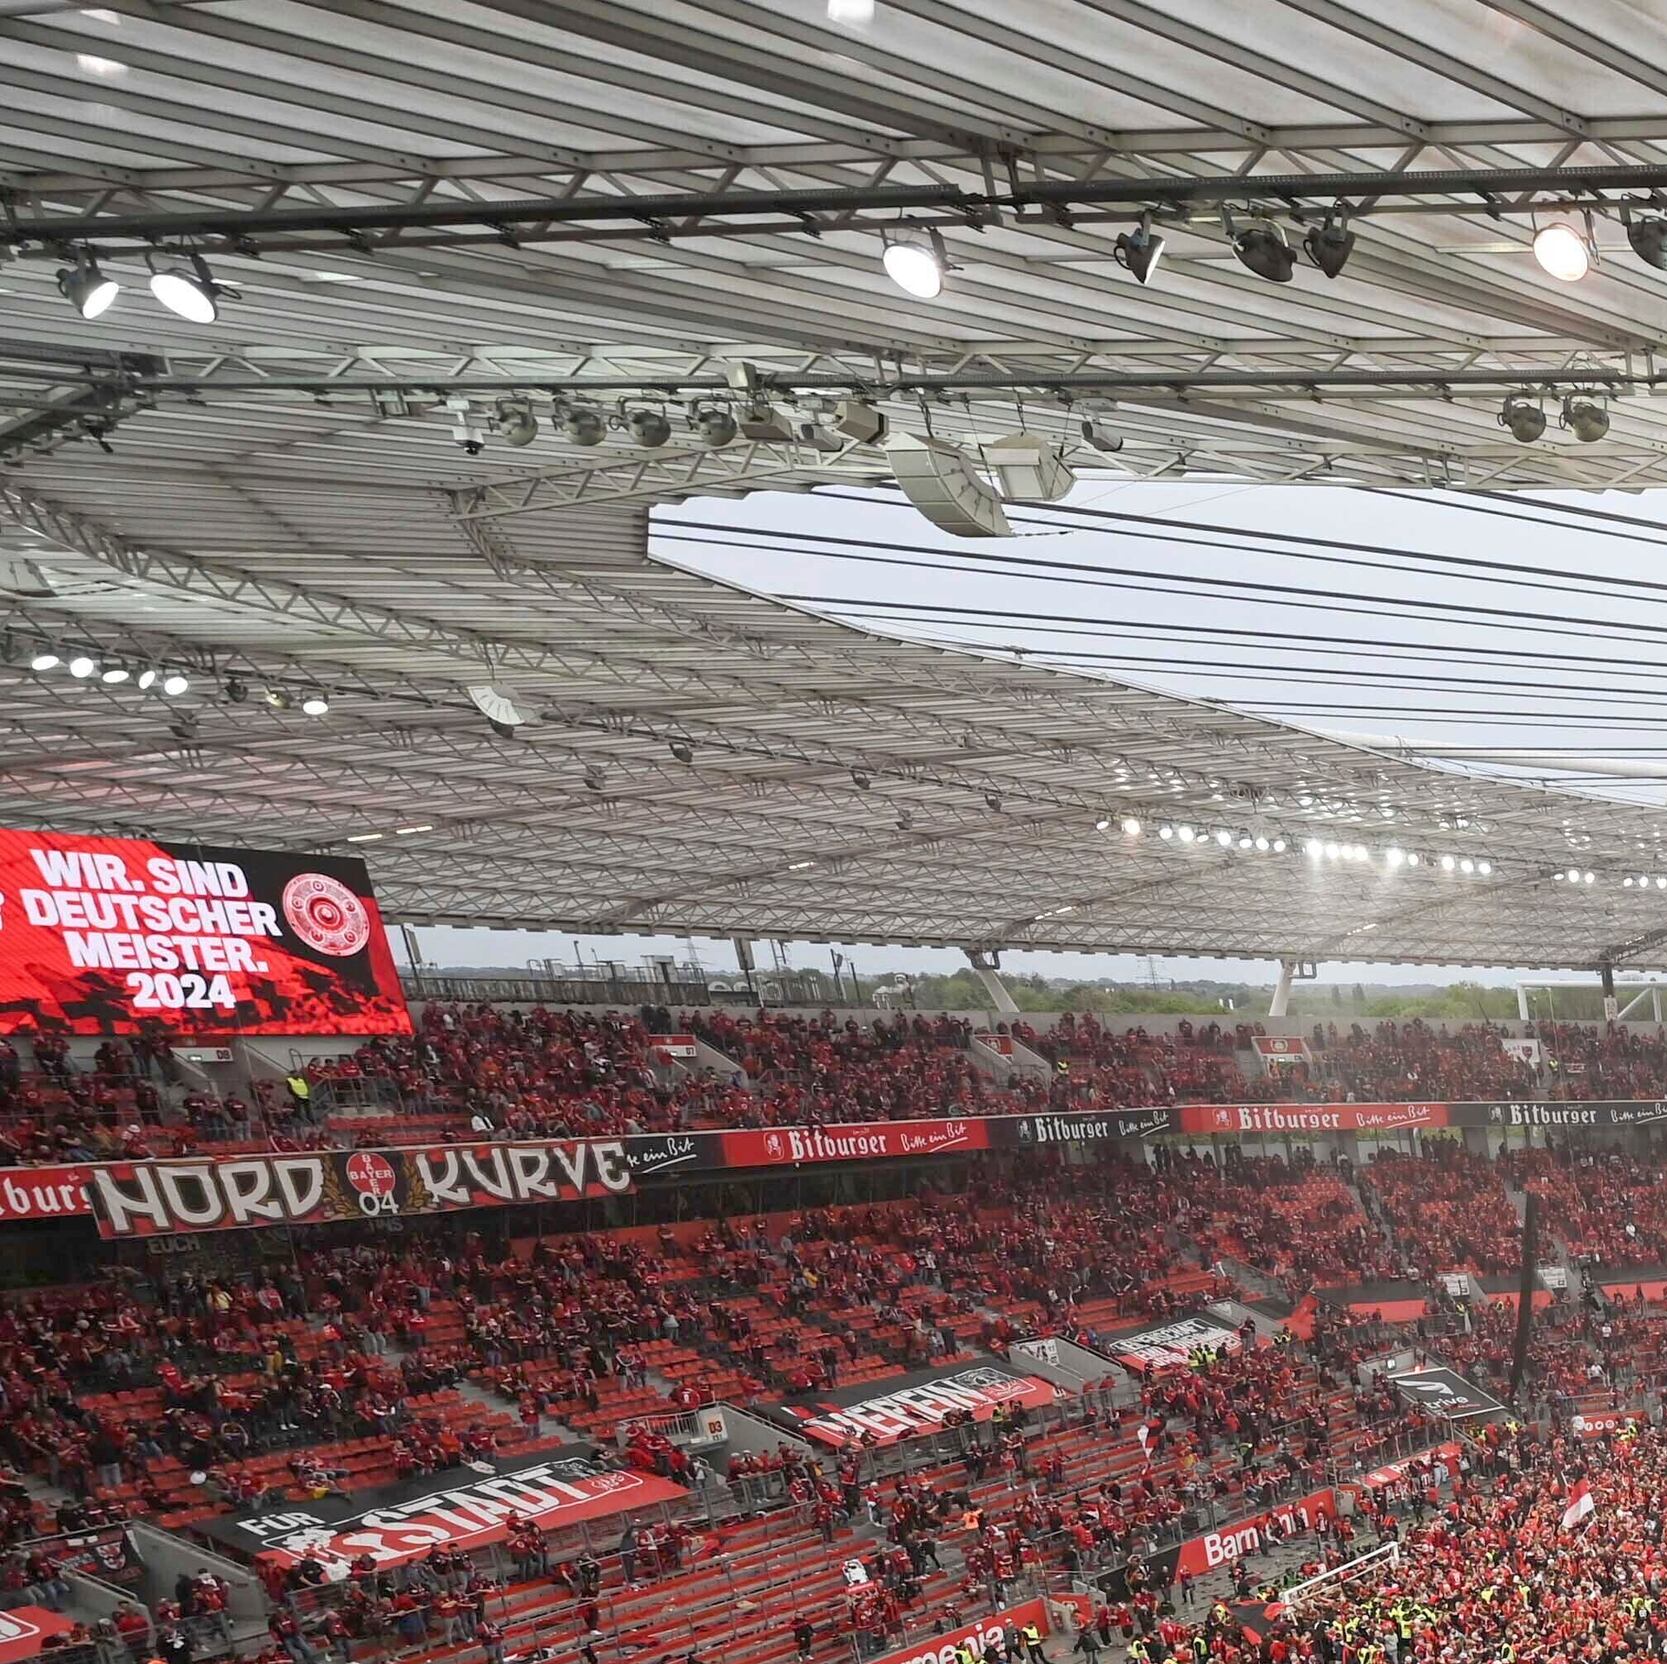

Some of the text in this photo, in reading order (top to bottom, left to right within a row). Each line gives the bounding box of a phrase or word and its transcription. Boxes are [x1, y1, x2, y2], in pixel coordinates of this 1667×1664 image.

[29, 849, 249, 898] WIR. SIND
[19, 888, 283, 937] DEUTSCHER
[62, 930, 269, 972] MEISTER.
[127, 972, 237, 1009] 2024
[1036, 1117, 1108, 1143] Bitburger
[1238, 1106, 1339, 1129] Bitburger
[1510, 1104, 1597, 1126] Bitburger
[790, 1128, 888, 1160] Bitburger
[350, 1169, 393, 1180] BAYER
[416, 1142, 631, 1205] KURVE
[93, 1158, 323, 1234] NORD
[359, 1190, 399, 1216] 04
[239, 1511, 325, 1536] FÜR
